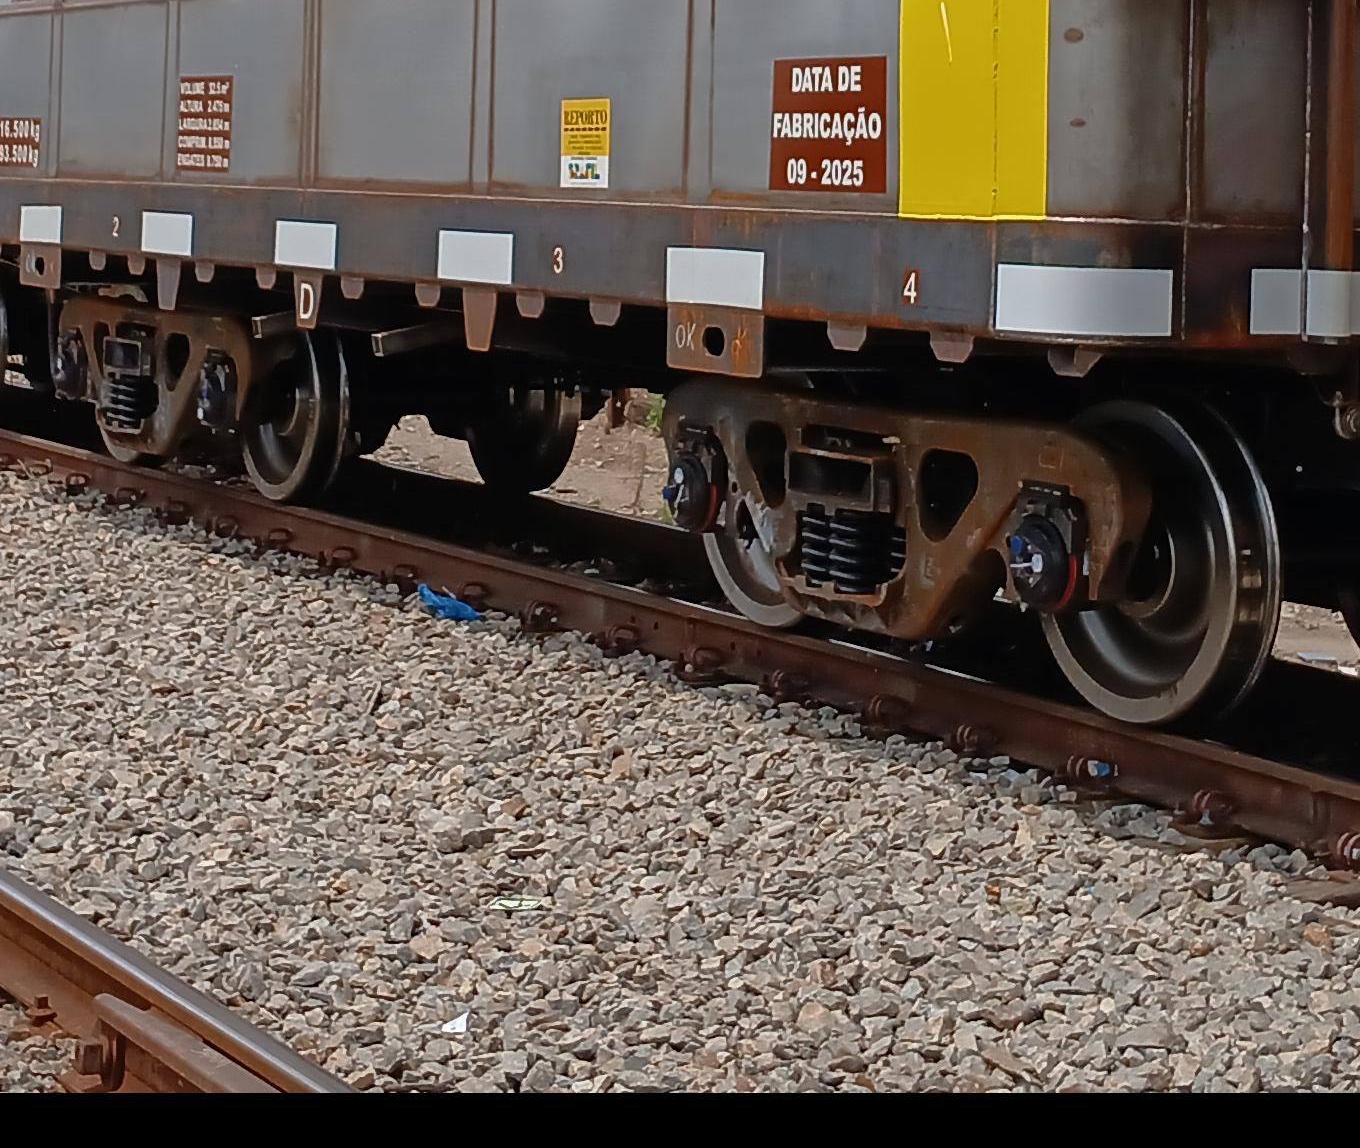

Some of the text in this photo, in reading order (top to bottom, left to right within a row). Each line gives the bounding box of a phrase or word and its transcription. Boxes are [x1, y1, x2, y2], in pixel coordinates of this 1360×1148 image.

[791, 65, 862, 93] DATA DE
[772, 106, 882, 146] FABRICAÇÃO
[787, 158, 807, 185] 09
[821, 158, 864, 187] 2025
[112, 216, 120, 237] 2
[553, 246, 564, 274] 3
[299, 283, 314, 320] D
[903, 272, 917, 304] 4
[676, 322, 696, 350] OK
